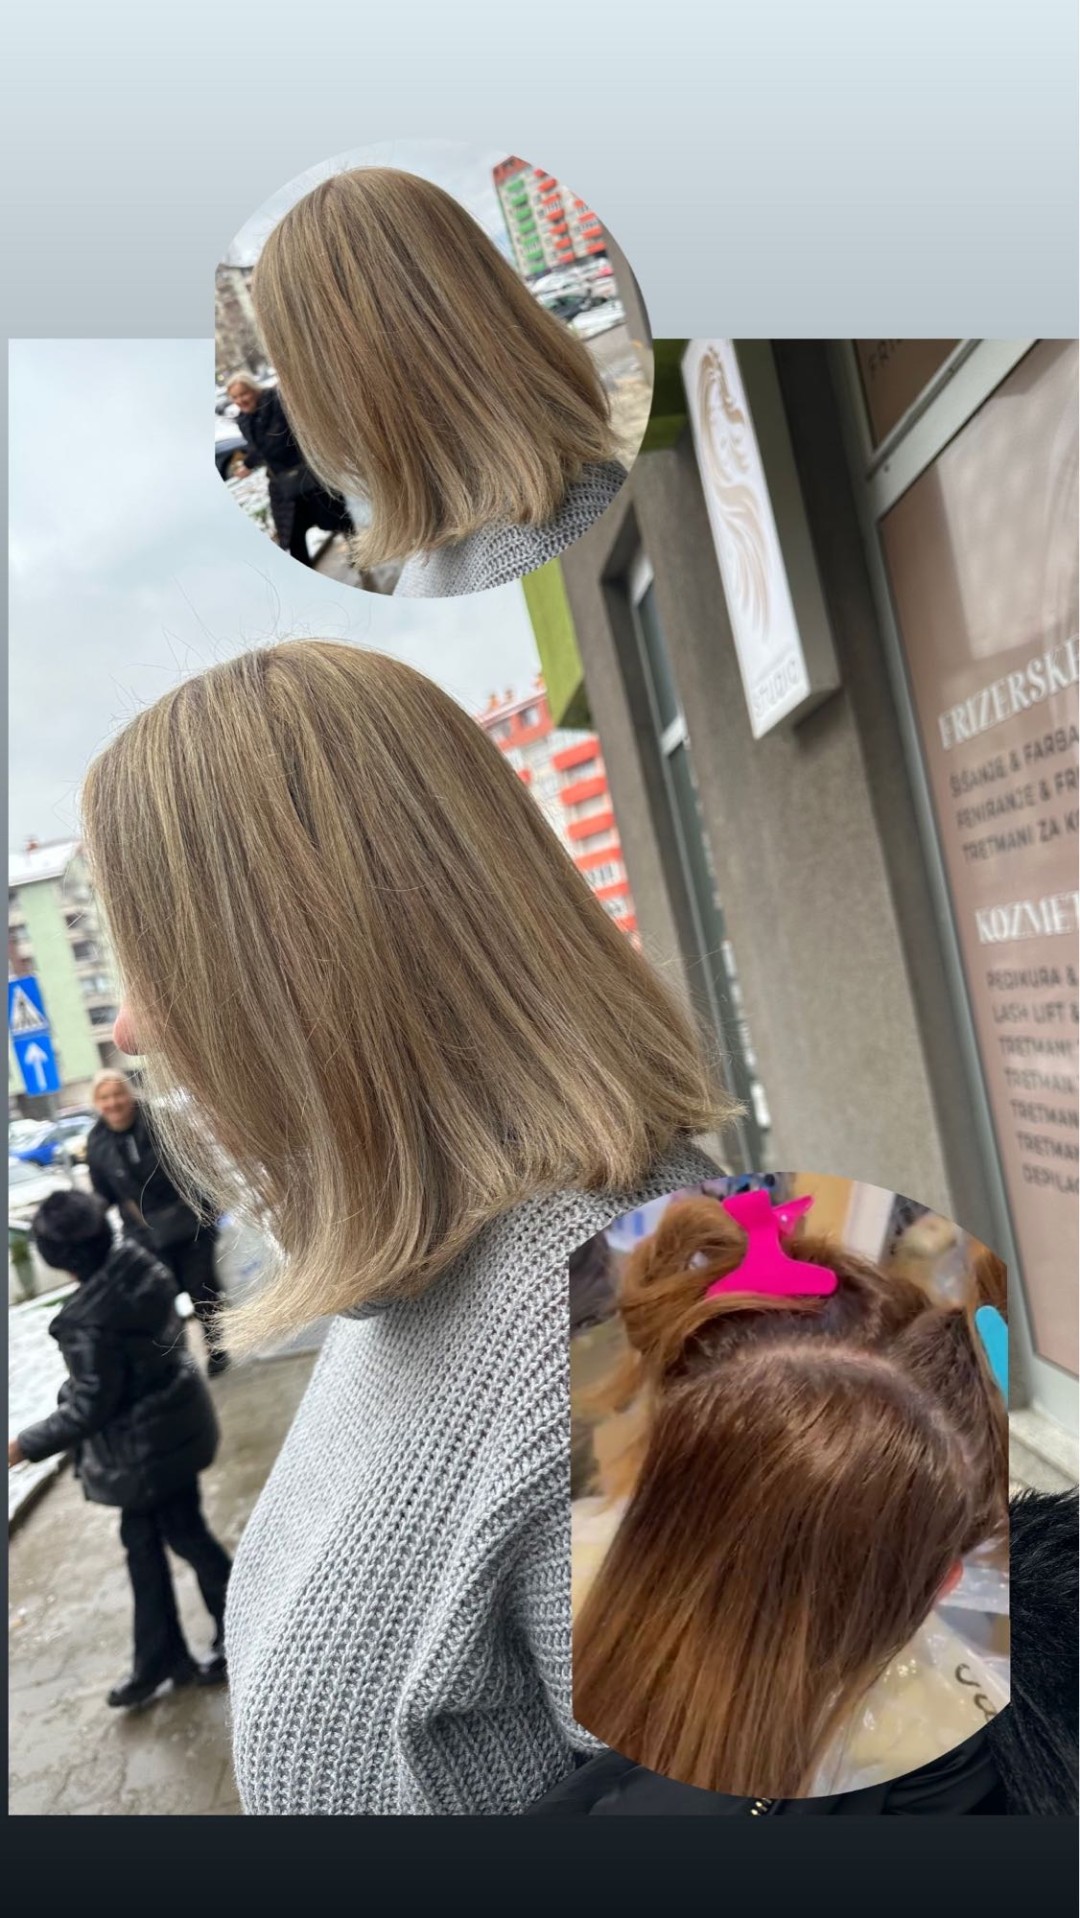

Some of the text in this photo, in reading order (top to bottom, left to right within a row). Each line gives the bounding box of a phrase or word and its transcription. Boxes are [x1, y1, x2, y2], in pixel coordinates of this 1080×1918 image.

[1008, 750, 1021, 773] &
[1038, 778, 1051, 802] &
[1037, 817, 1060, 843] ZA
[986, 966, 1060, 991] PEDIKURA
